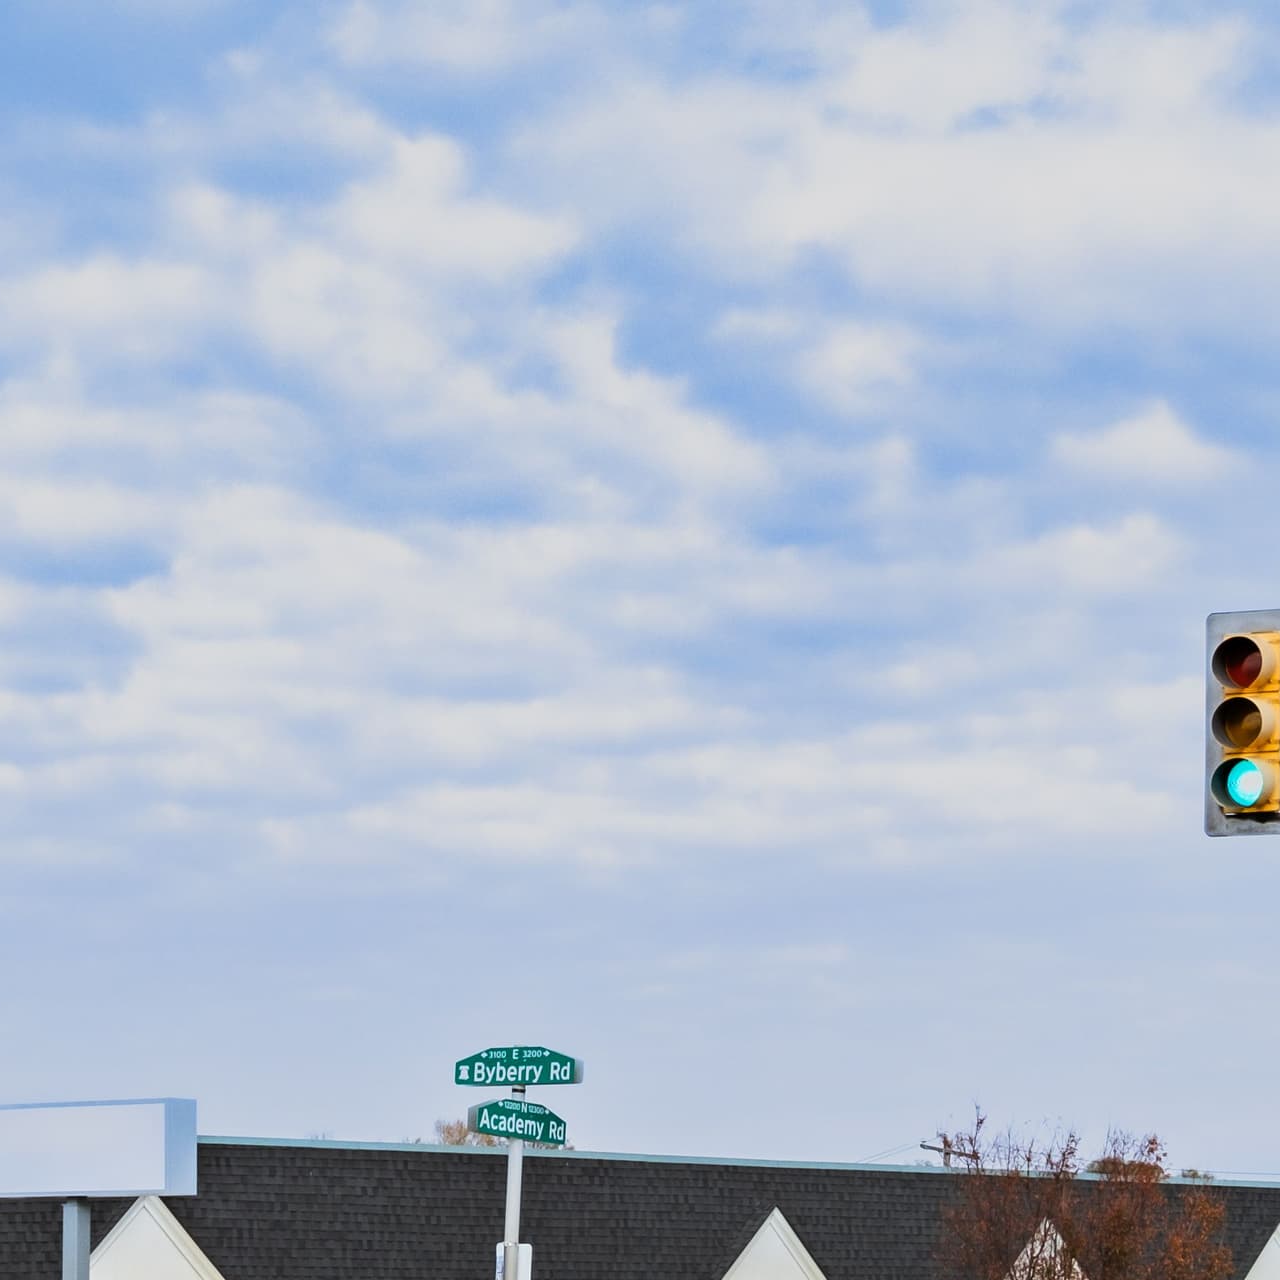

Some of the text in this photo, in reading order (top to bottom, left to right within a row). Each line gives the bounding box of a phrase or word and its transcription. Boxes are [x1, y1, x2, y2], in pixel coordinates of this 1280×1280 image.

[488, 1048, 542, 1060] 3100 E 3200
[473, 1061, 571, 1083] Byberry Rd
[521, 1102, 528, 1113] N
[479, 1108, 566, 1140] Academy Rd
